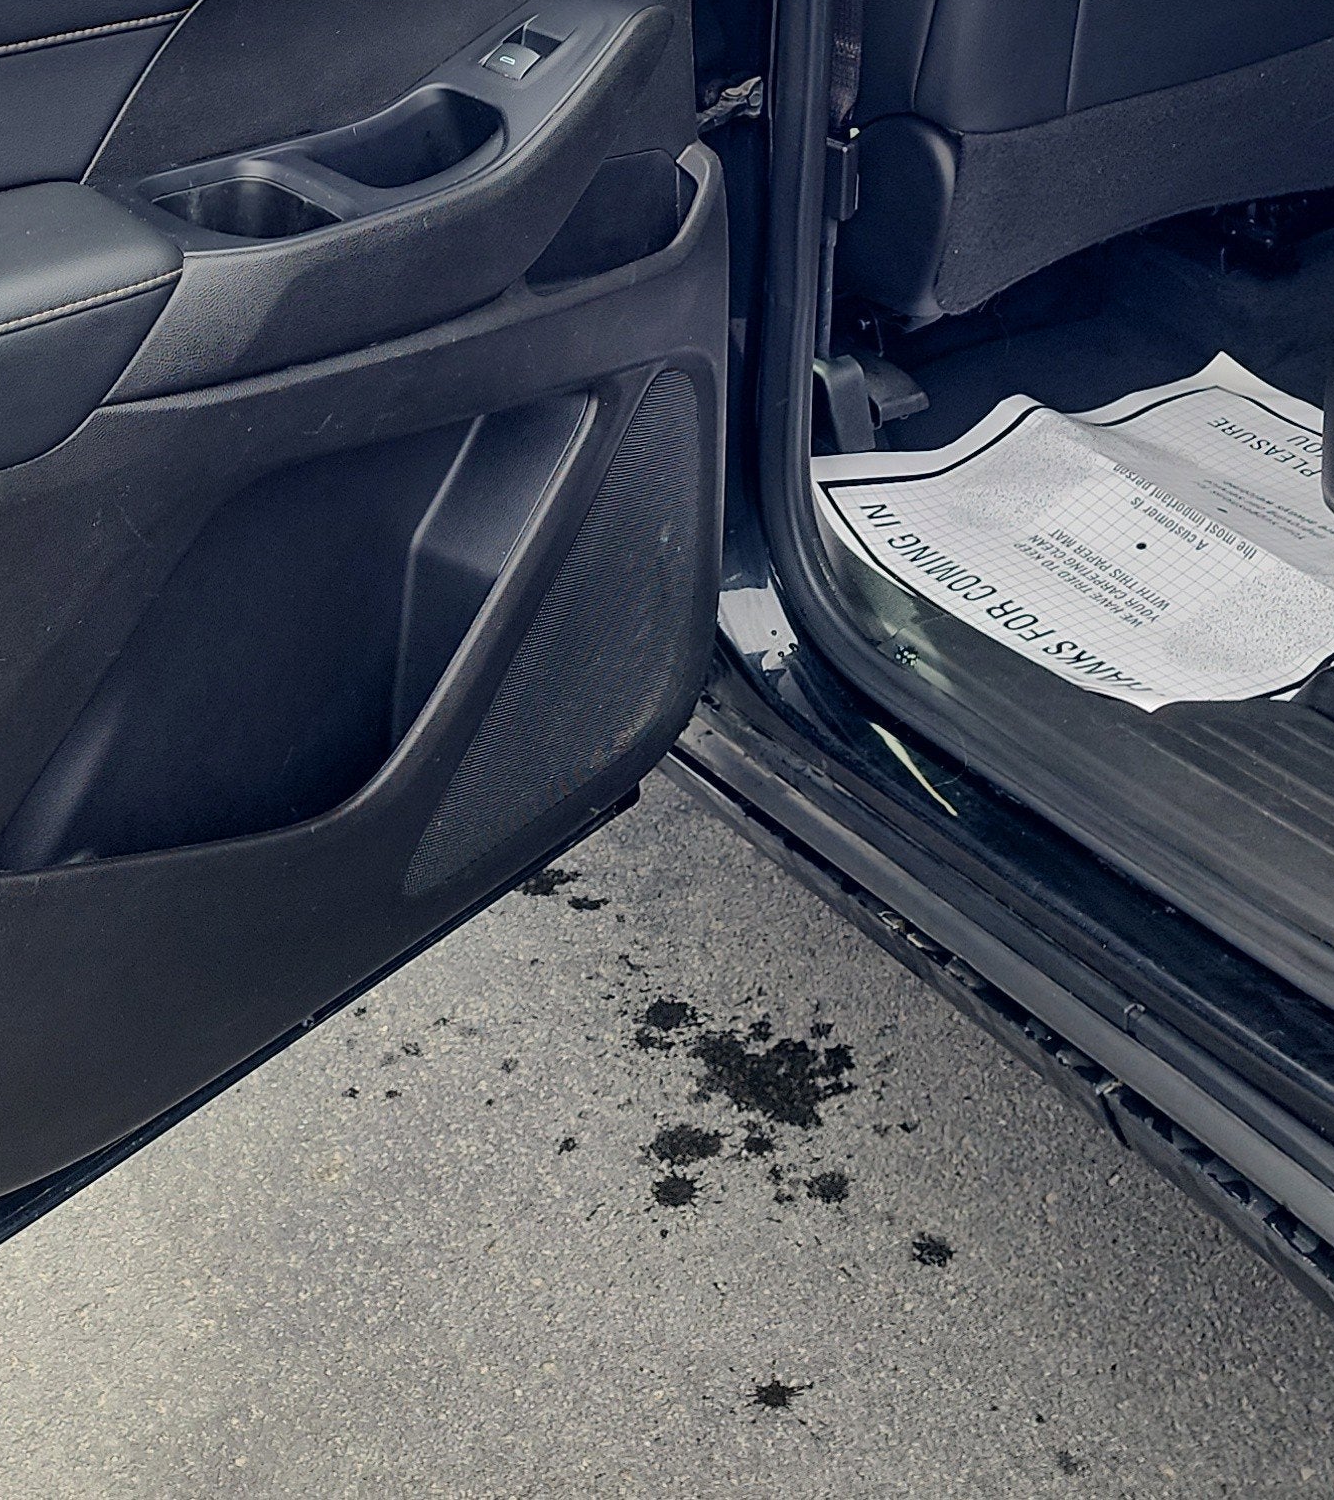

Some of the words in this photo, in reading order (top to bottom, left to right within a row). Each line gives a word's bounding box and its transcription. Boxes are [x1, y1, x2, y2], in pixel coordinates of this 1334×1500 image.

[1207, 417, 1323, 478] PLEASURE
[1112, 463, 1153, 492] person
[860, 503, 902, 528] IN
[1149, 486, 1207, 526] important
[1142, 505, 1198, 544] customer
[1204, 521, 1237, 546] most
[1027, 534, 1067, 559] CLEAN
[1048, 528, 1078, 548] MAT
[1195, 539, 1209, 551] A
[1235, 541, 1258, 560] the
[1013, 542, 1043, 561] KEEP
[1073, 544, 1113, 572] PAPER
[888, 533, 997, 601] COMING
[1041, 559, 1060, 573] TO
[1057, 571, 1092, 595] TRIED
[1062, 557, 1128, 601] CARPETING
[1108, 568, 1139, 590] THIS
[1089, 592, 1124, 614] HAVE
[1124, 598, 1160, 623] YOUR
[1135, 587, 1171, 612] WITH
[986, 600, 1056, 642] FOR
[1119, 613, 1143, 628] WE
[1043, 640, 1166, 697] HANKS
